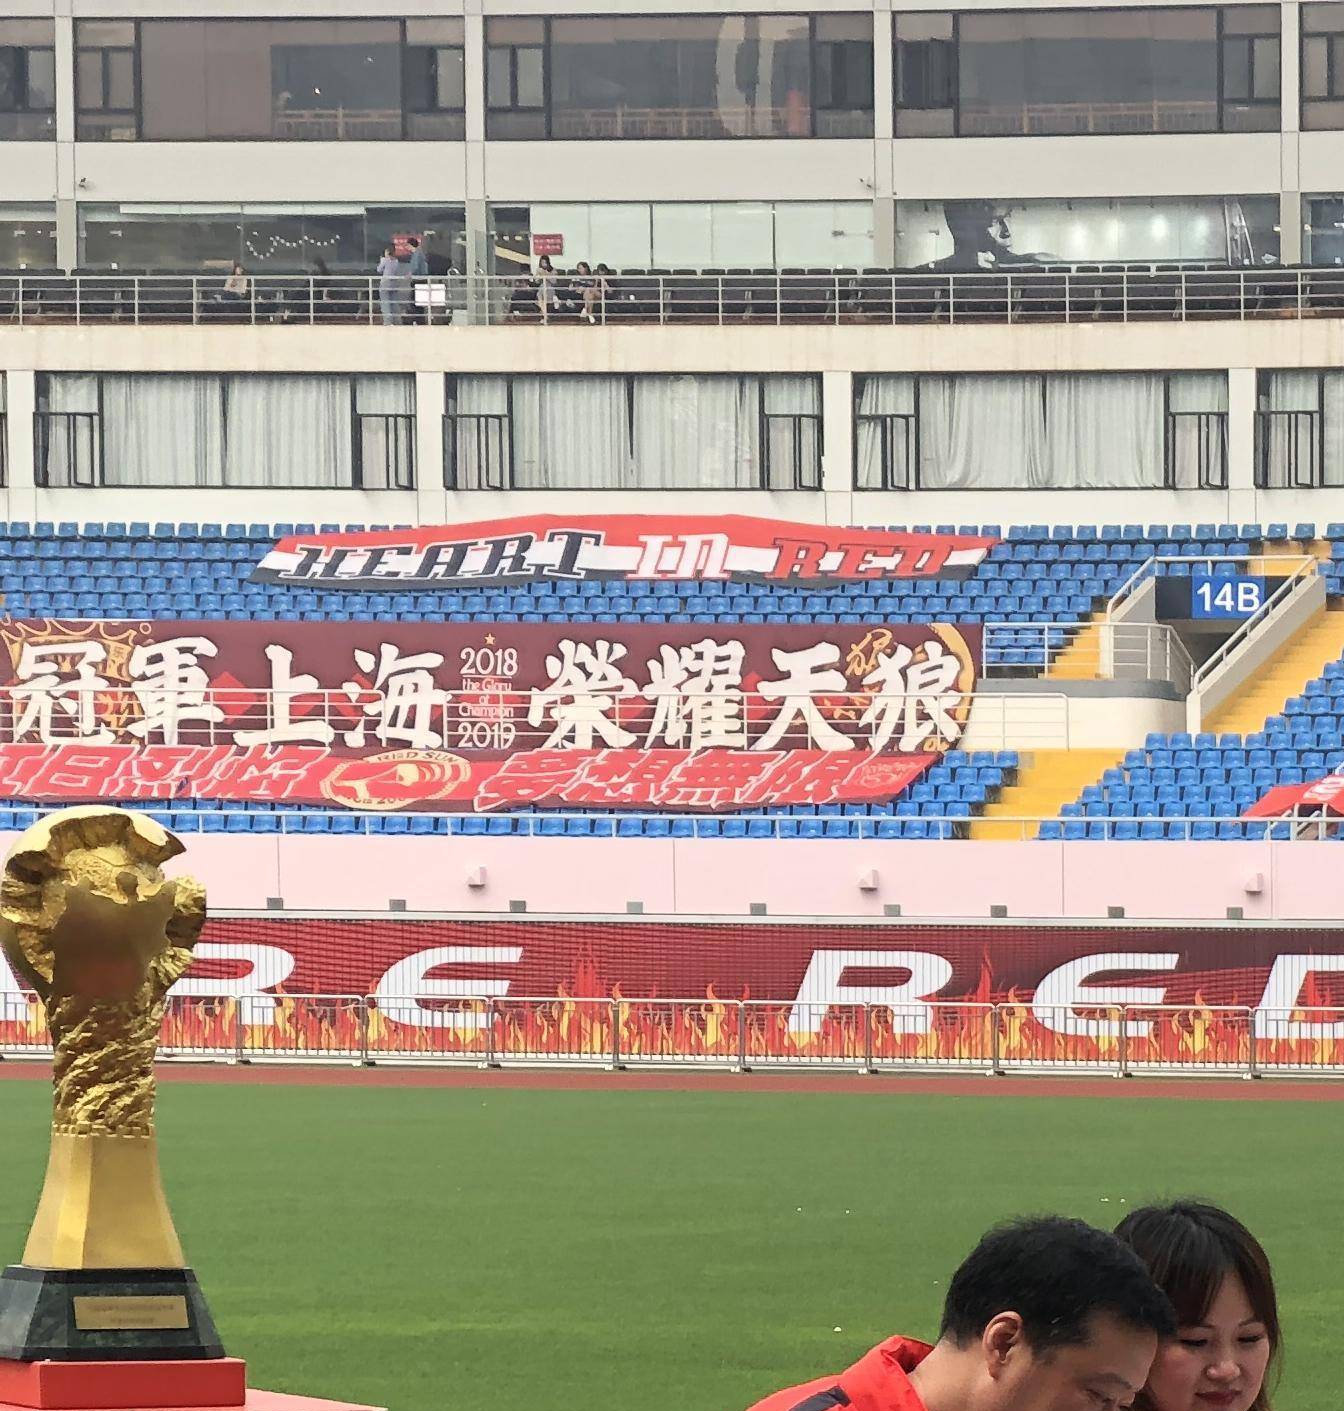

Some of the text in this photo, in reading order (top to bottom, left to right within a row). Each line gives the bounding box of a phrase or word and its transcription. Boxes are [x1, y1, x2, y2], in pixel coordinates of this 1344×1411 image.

[280, 530, 607, 582] HEART
[764, 537, 953, 580] RED
[1196, 582, 1260, 612] 14B
[460, 647, 518, 676] 2018
[8, 635, 454, 750] 冠軍上海
[462, 678, 512, 693] the Glory
[526, 638, 963, 752] 榮耀天狼
[458, 721, 516, 750] 2019
